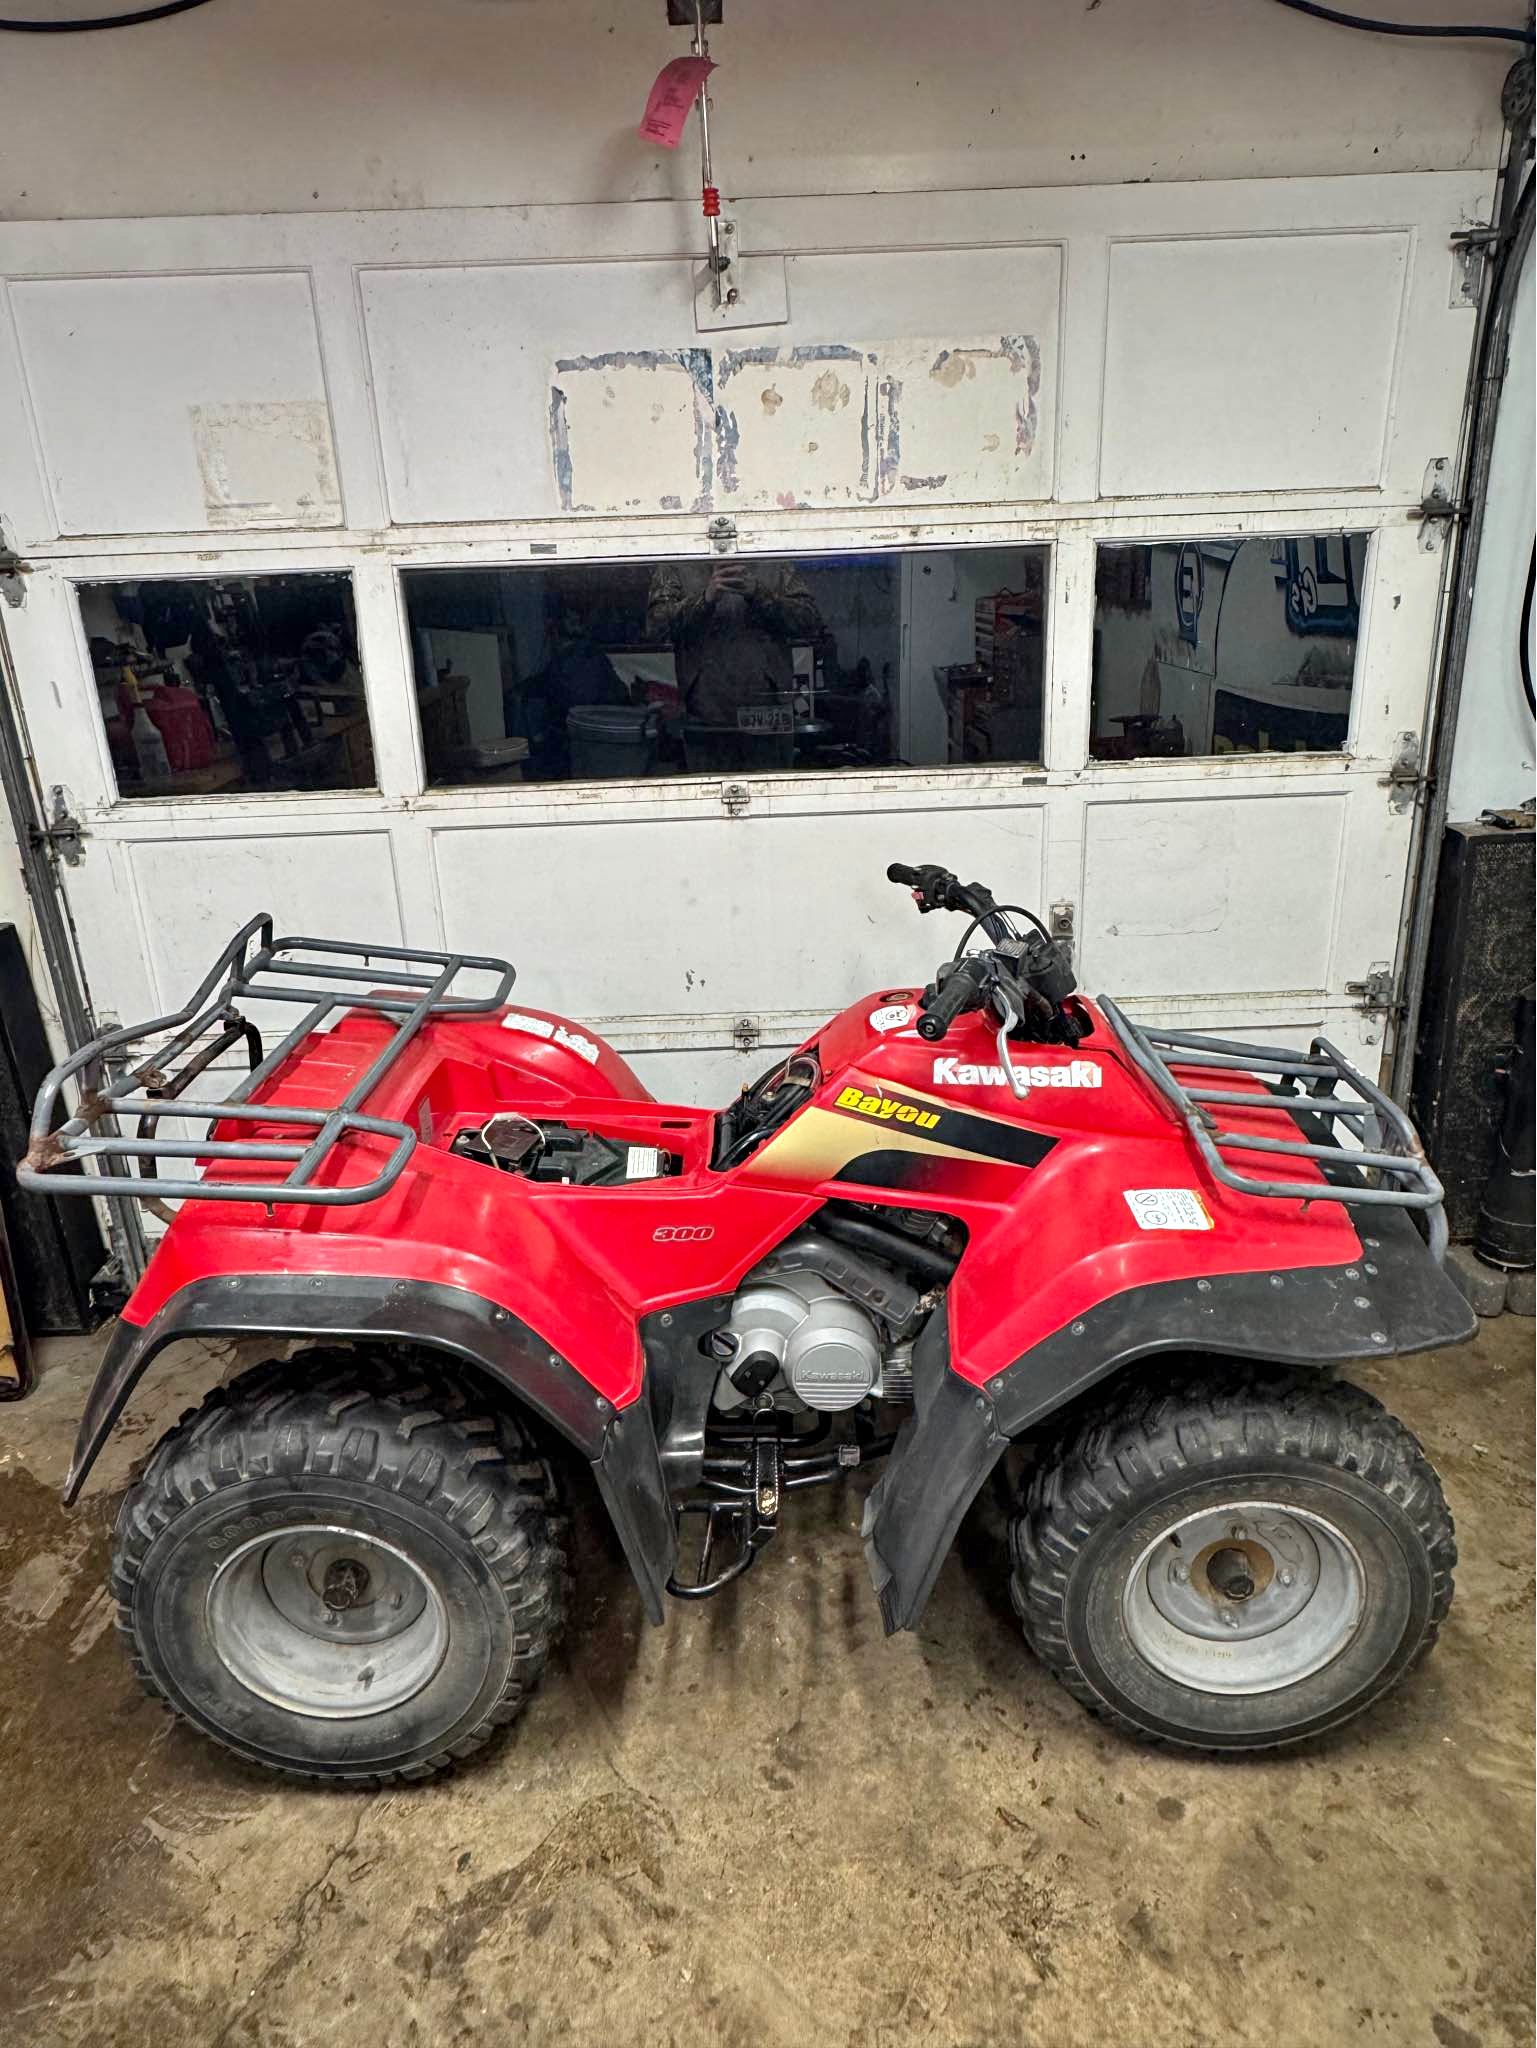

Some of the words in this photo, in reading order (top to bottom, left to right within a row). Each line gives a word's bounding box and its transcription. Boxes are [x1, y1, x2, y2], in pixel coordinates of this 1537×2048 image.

[933, 1057, 1103, 1088] Kawasaki
[835, 1086, 941, 1129] Bayou
[653, 1226, 715, 1242] 300
